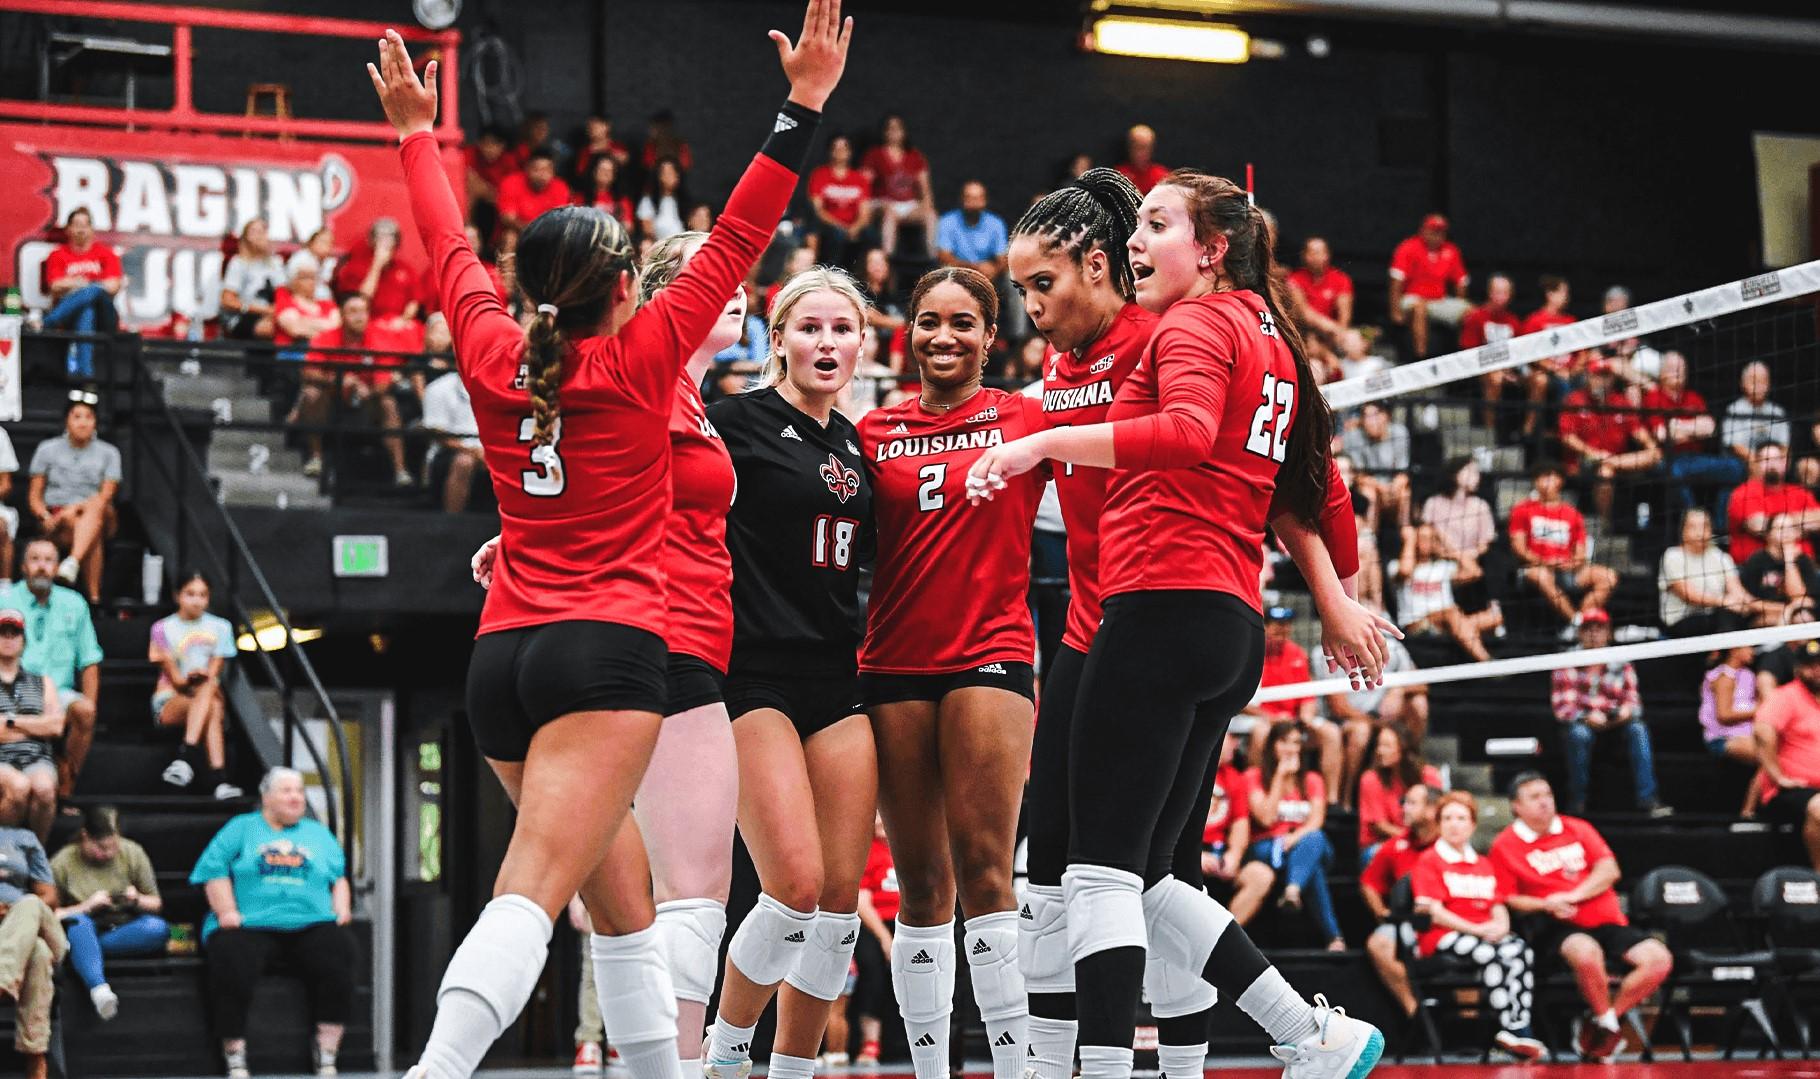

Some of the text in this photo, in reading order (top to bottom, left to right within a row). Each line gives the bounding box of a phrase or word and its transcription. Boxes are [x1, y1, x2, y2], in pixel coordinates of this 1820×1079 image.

[875, 427, 1006, 464] LOUISIANA
[1244, 371, 1295, 464] 22
[517, 415, 568, 497] 3
[918, 462, 949, 512] 2
[812, 514, 861, 571] 18
